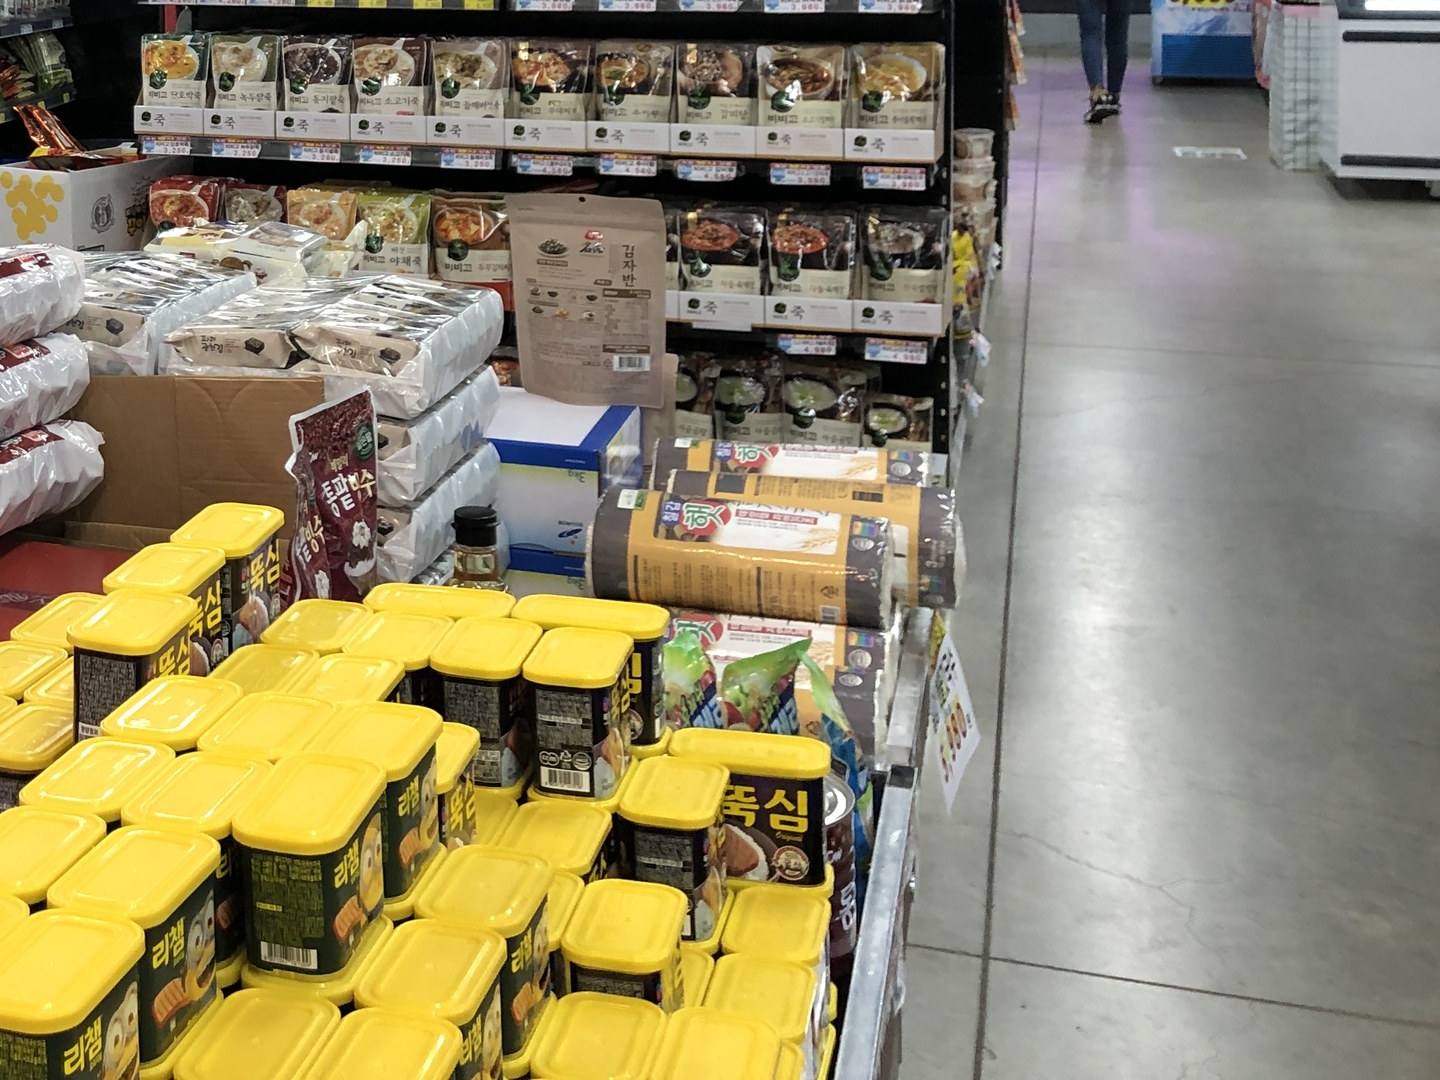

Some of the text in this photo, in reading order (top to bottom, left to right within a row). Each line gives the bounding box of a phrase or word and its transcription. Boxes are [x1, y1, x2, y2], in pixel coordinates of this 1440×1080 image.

[390, 255, 422, 266] 야채죽
[622, 244, 637, 287] 김자반
[250, 538, 281, 592] 뚝심
[152, 916, 185, 970] 리챔
[64, 1015, 102, 1076] 리챔
